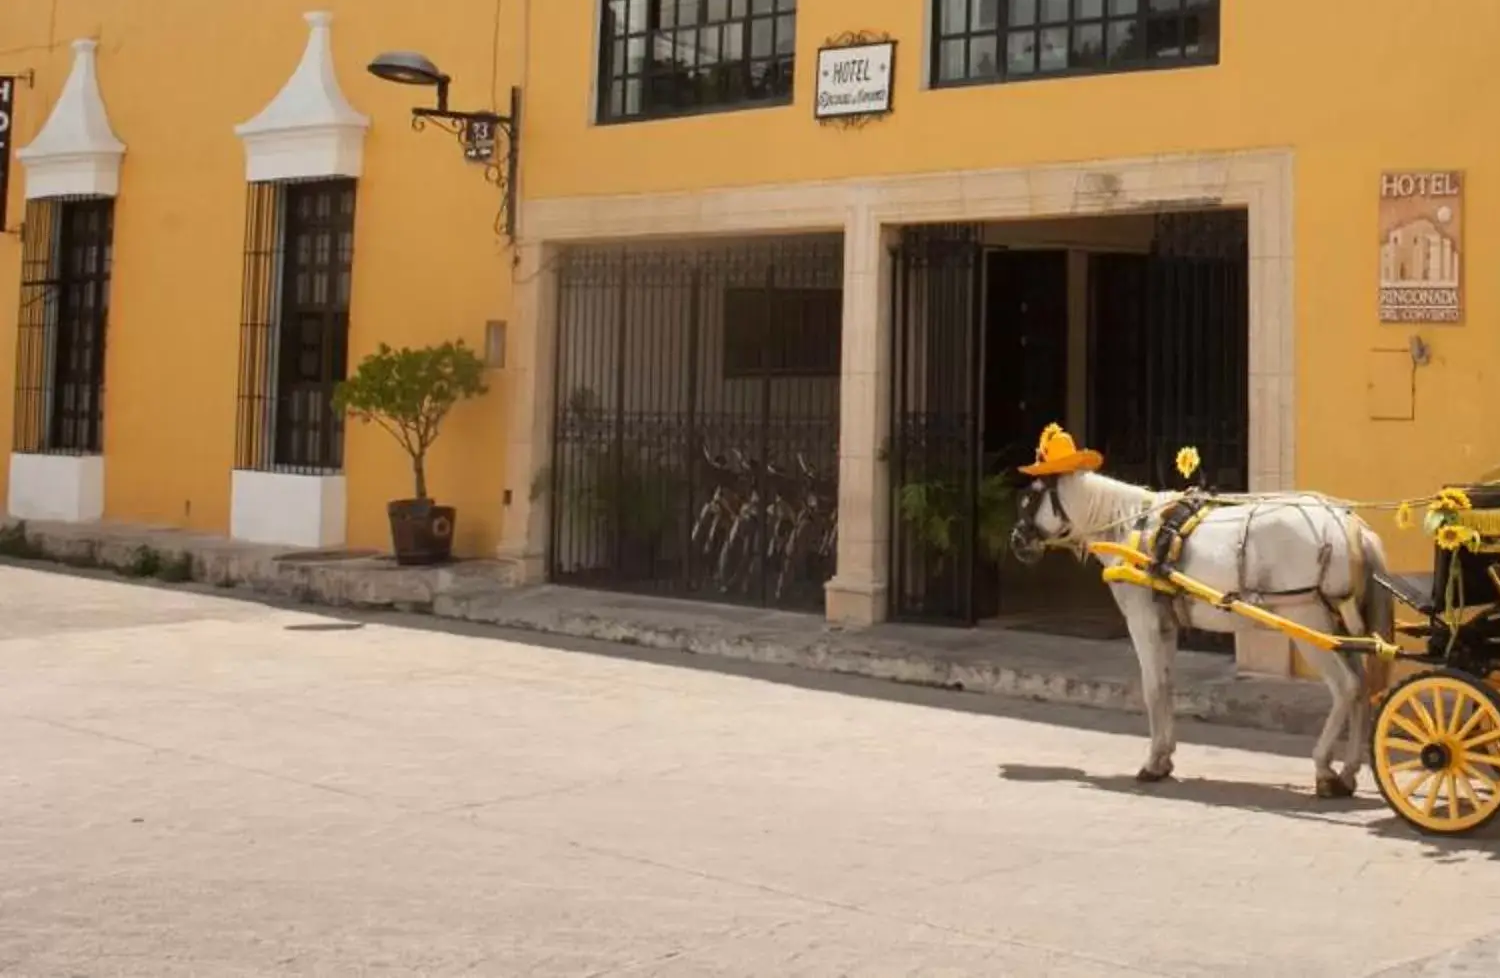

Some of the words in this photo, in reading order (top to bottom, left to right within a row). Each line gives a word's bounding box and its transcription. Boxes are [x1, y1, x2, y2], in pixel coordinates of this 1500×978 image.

[833, 59, 872, 85] HOTEL
[1381, 173, 1459, 197] HOTEL
[1380, 289, 1459, 305] RINCONADA
